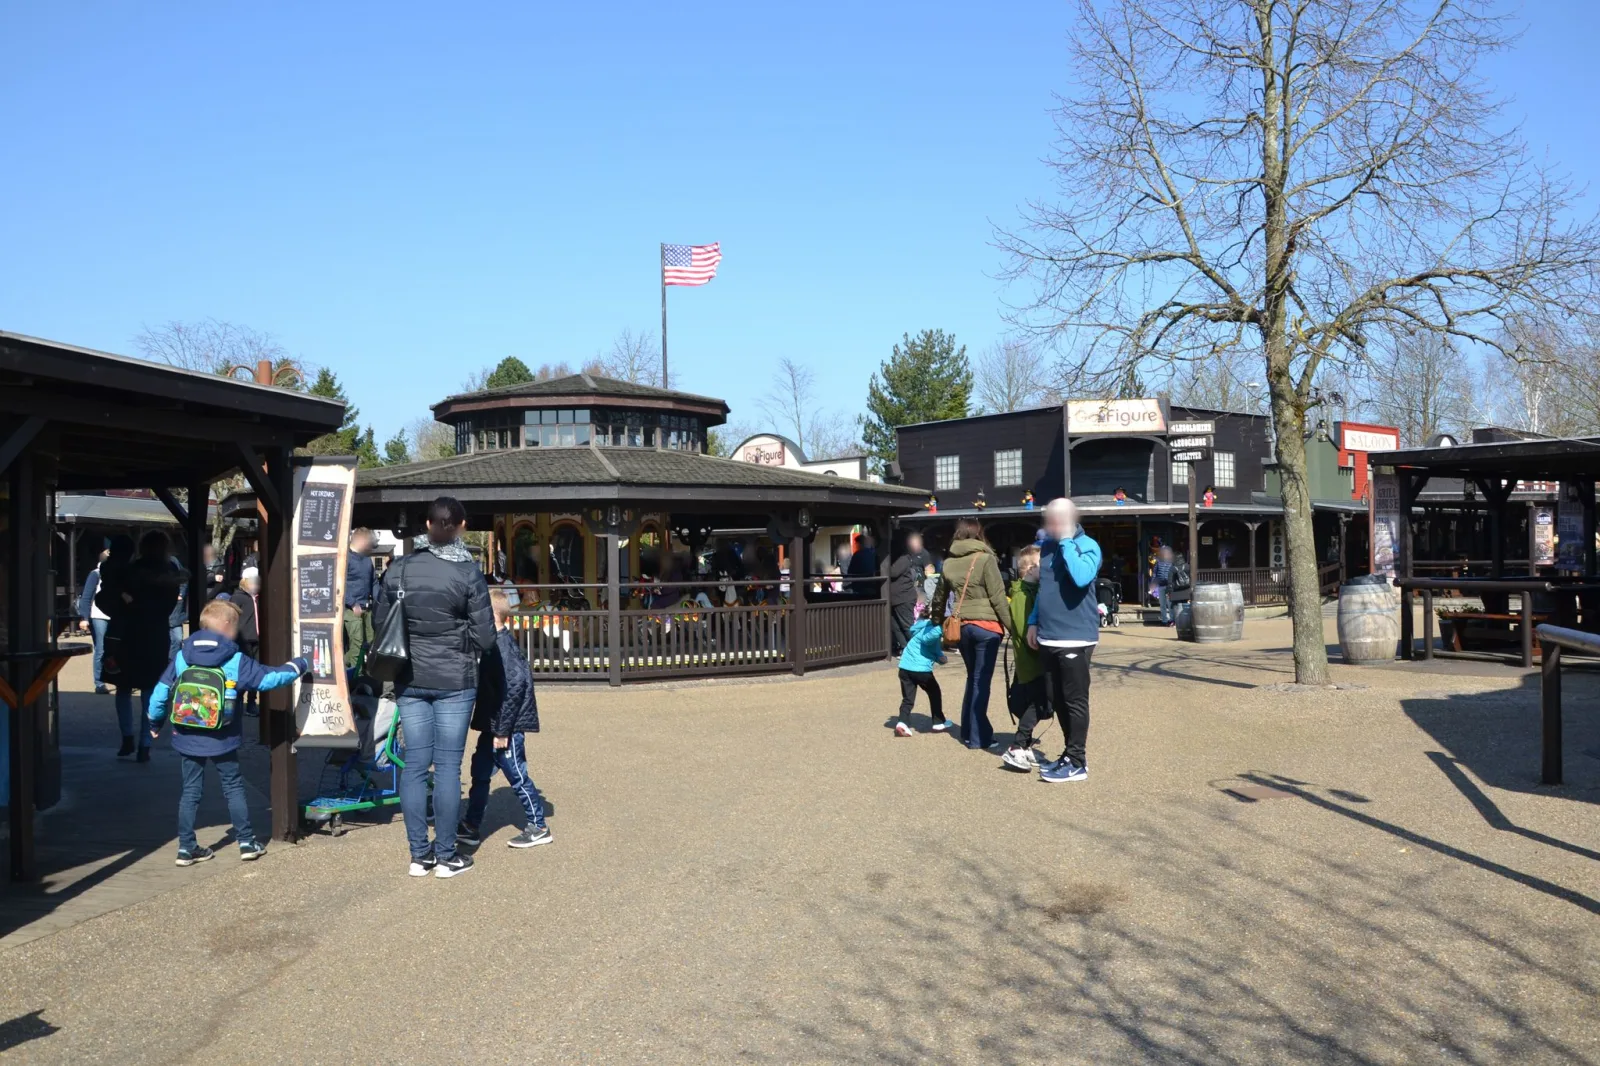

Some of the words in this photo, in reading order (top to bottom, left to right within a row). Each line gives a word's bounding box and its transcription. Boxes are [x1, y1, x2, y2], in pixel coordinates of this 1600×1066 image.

[1106, 409, 1157, 426] Figure
[1350, 434, 1392, 450] SALOON
[760, 450, 782, 464] Figure
[318, 490, 335, 498] DRINKS
[1377, 487, 1397, 498] GRILL
[1375, 499, 1399, 510] HOUSE
[300, 688, 332, 704] Coffee
